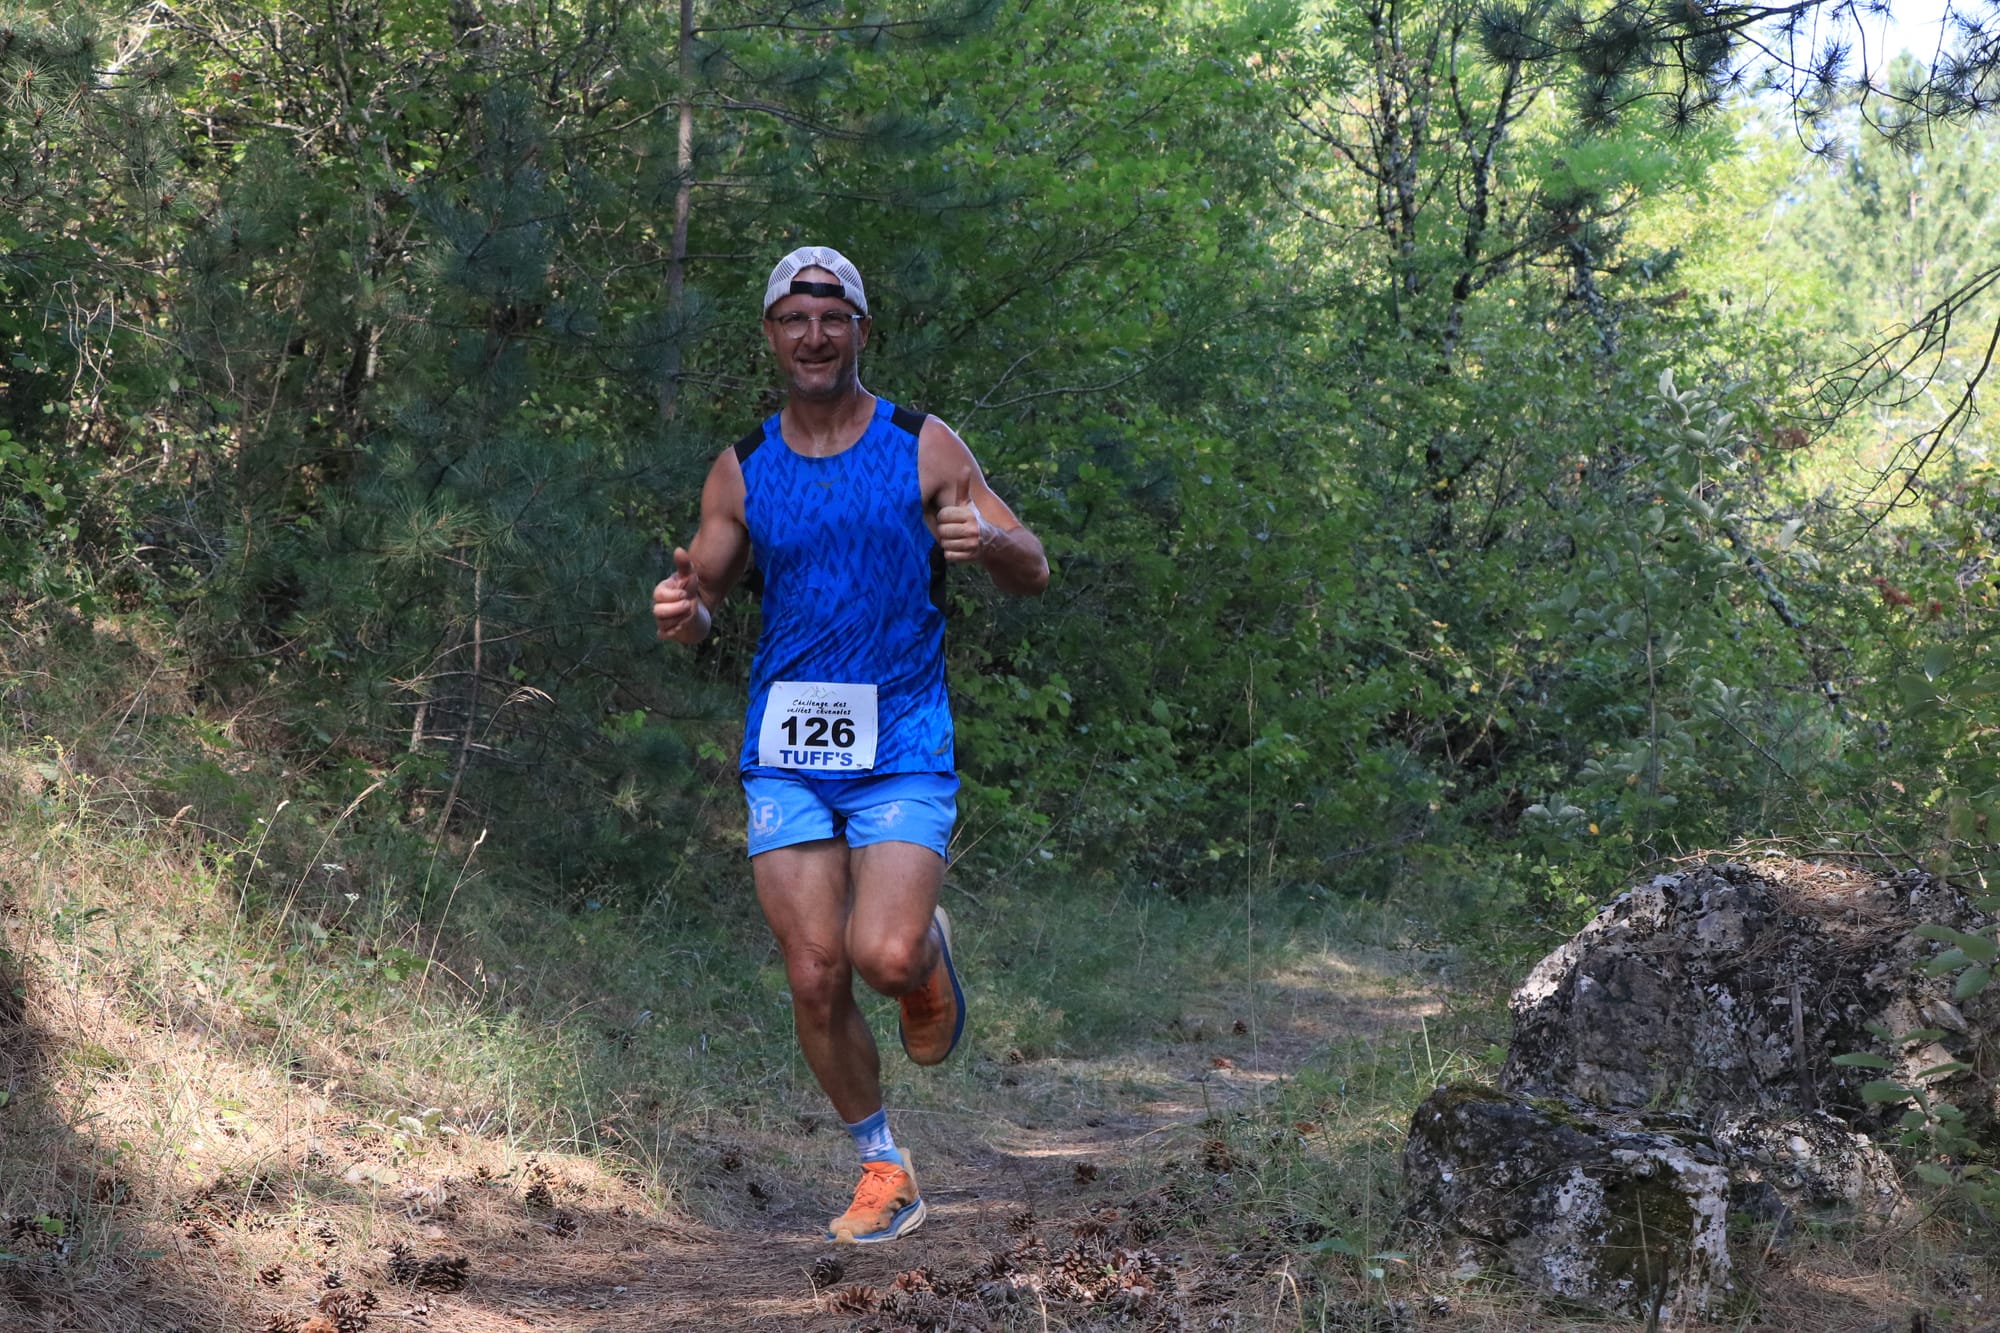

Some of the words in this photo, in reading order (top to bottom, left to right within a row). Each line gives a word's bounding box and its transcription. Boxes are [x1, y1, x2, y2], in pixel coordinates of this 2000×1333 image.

[793, 699, 828, 709] Challenge
[781, 715, 856, 748] 126
[779, 750, 853, 767] TUFF'S
